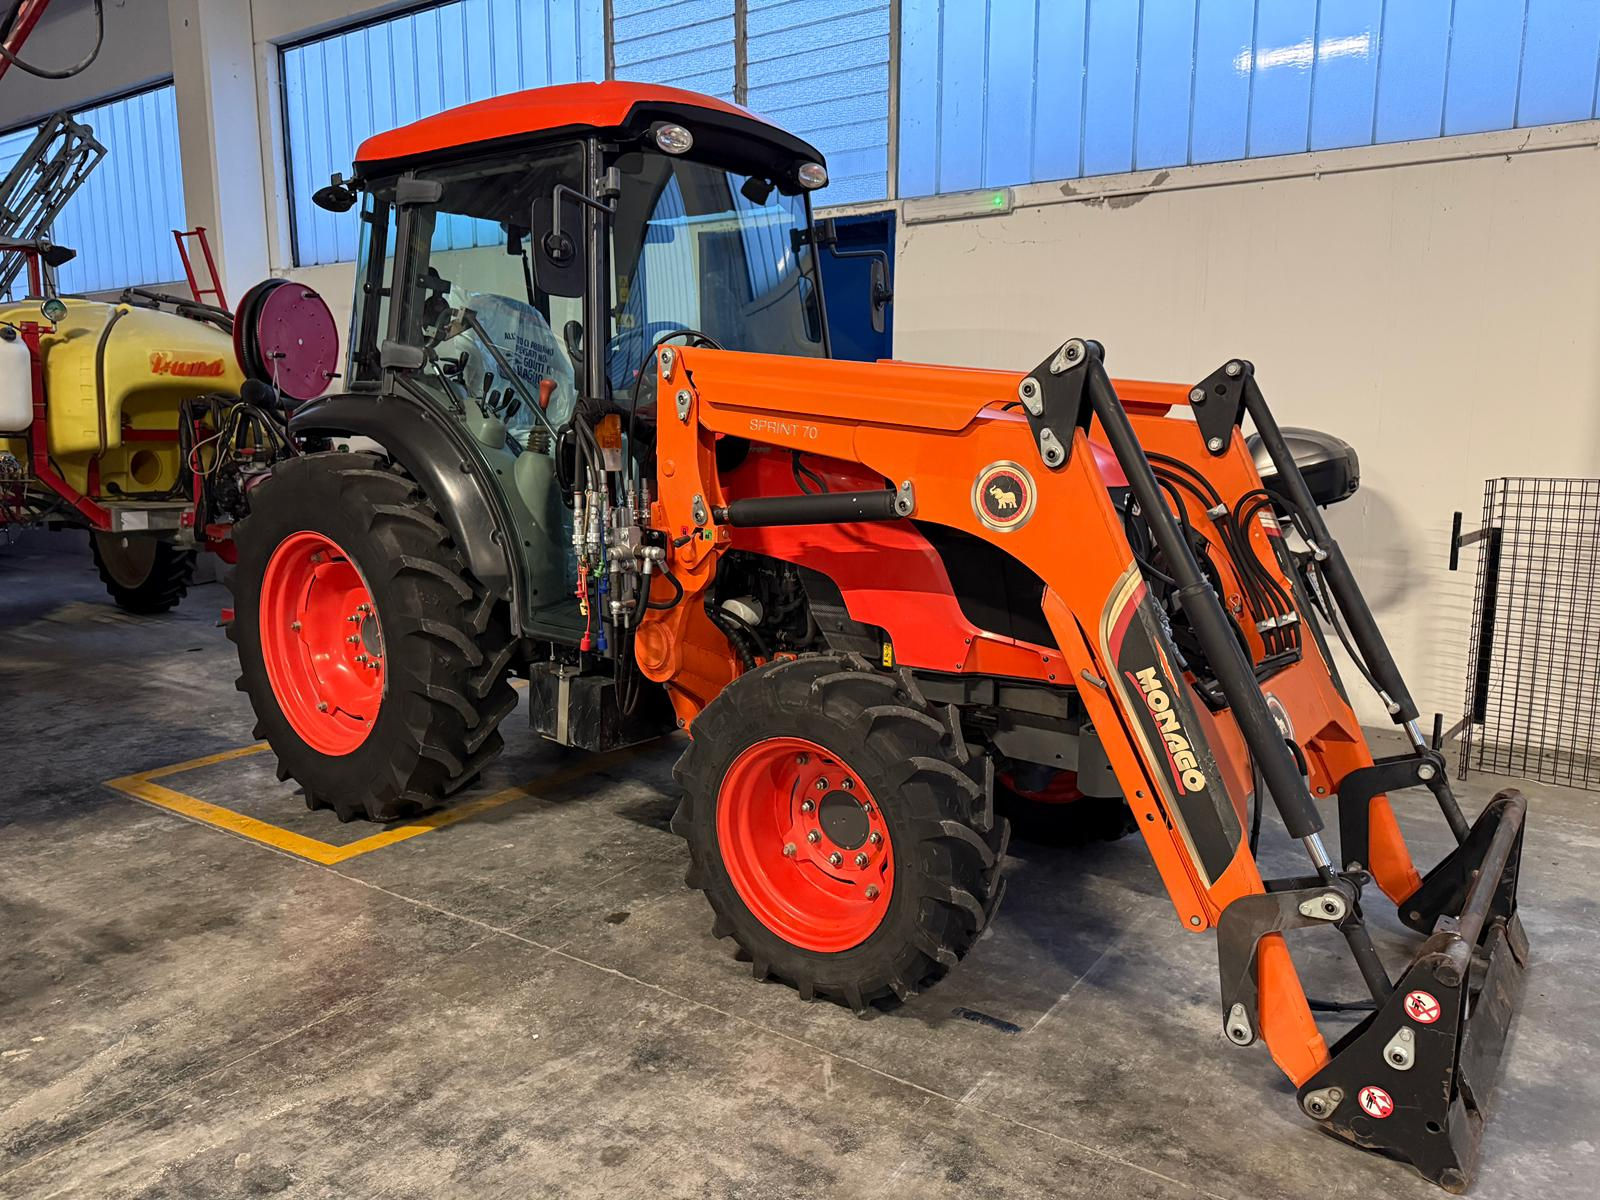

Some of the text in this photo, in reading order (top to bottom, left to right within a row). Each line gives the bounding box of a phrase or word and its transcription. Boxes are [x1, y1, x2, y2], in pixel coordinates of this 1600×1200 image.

[750, 418, 818, 440] SPRINT 70
[1135, 666, 1206, 792] MONAGO
